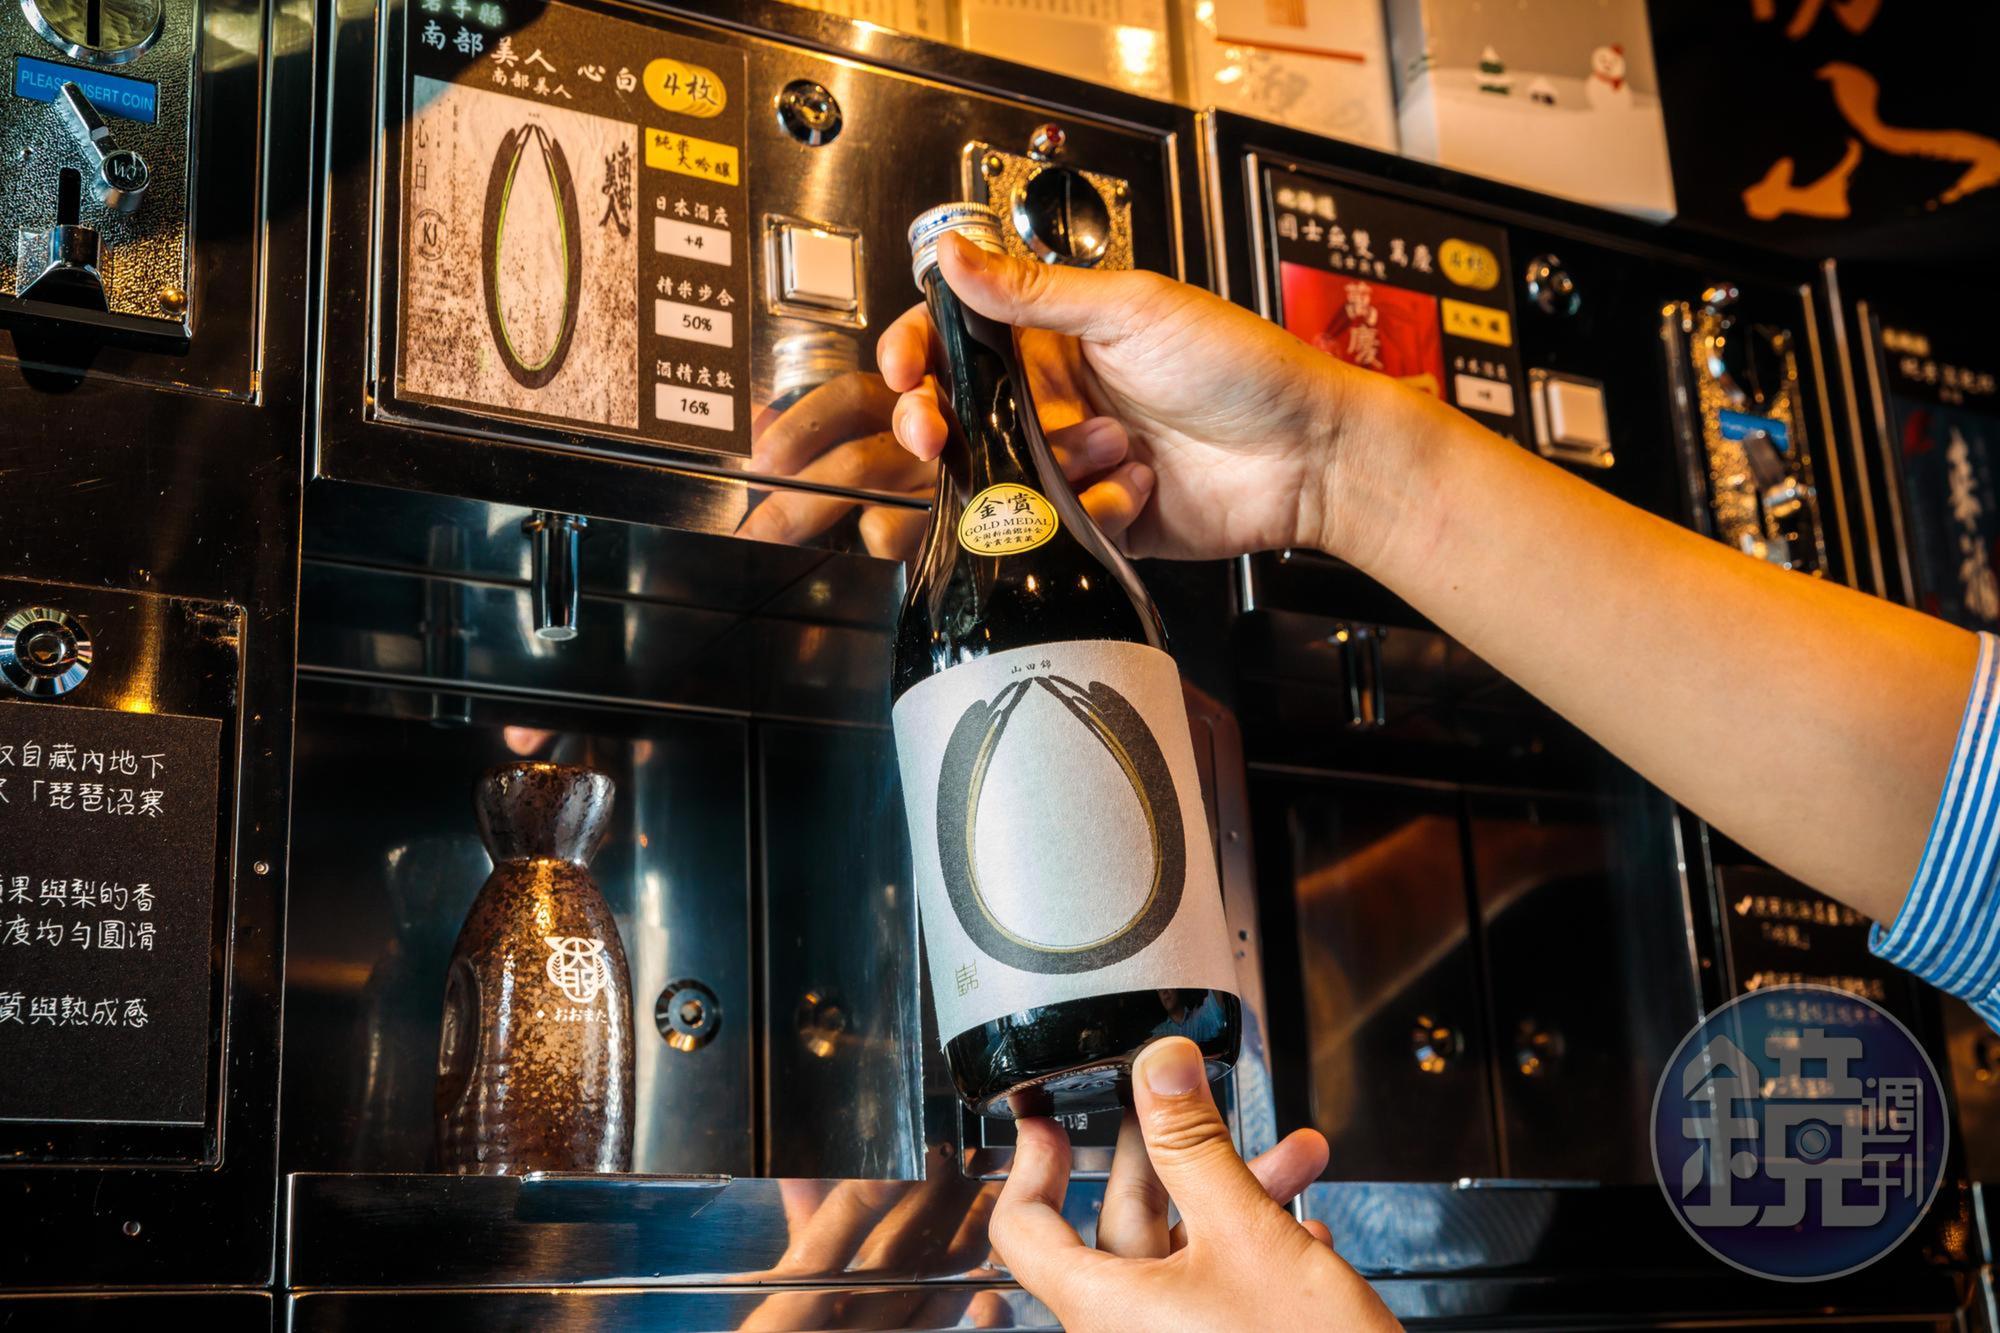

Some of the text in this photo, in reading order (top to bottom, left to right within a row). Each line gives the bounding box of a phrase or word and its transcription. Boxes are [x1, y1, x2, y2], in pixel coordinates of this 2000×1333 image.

[421, 19, 637, 93] 南部美人 心白
[21, 70, 153, 111] PLEAS NSERT COIN
[492, 66, 573, 99] 南部美人
[663, 72, 718, 107] 4枚
[414, 118, 429, 191] 心白
[656, 195, 729, 227] 日本酒度
[684, 233, 704, 250] +4
[682, 313, 712, 332] 50%
[656, 359, 735, 389] 酒精度數
[680, 398, 710, 416] 16%
[974, 492, 1036, 519] 金賞
[964, 517, 1051, 537] GOLD MEDAL
[1011, 659, 1051, 674] 山田錦
[0, 777, 164, 818] 「琵琶沼寒
[0, 873, 156, 912] 果與梨的香
[0, 913, 156, 951] 度均勻圓滑
[0, 991, 149, 1028] 質與熟成感
[554, 1007, 608, 1023] おおまた
